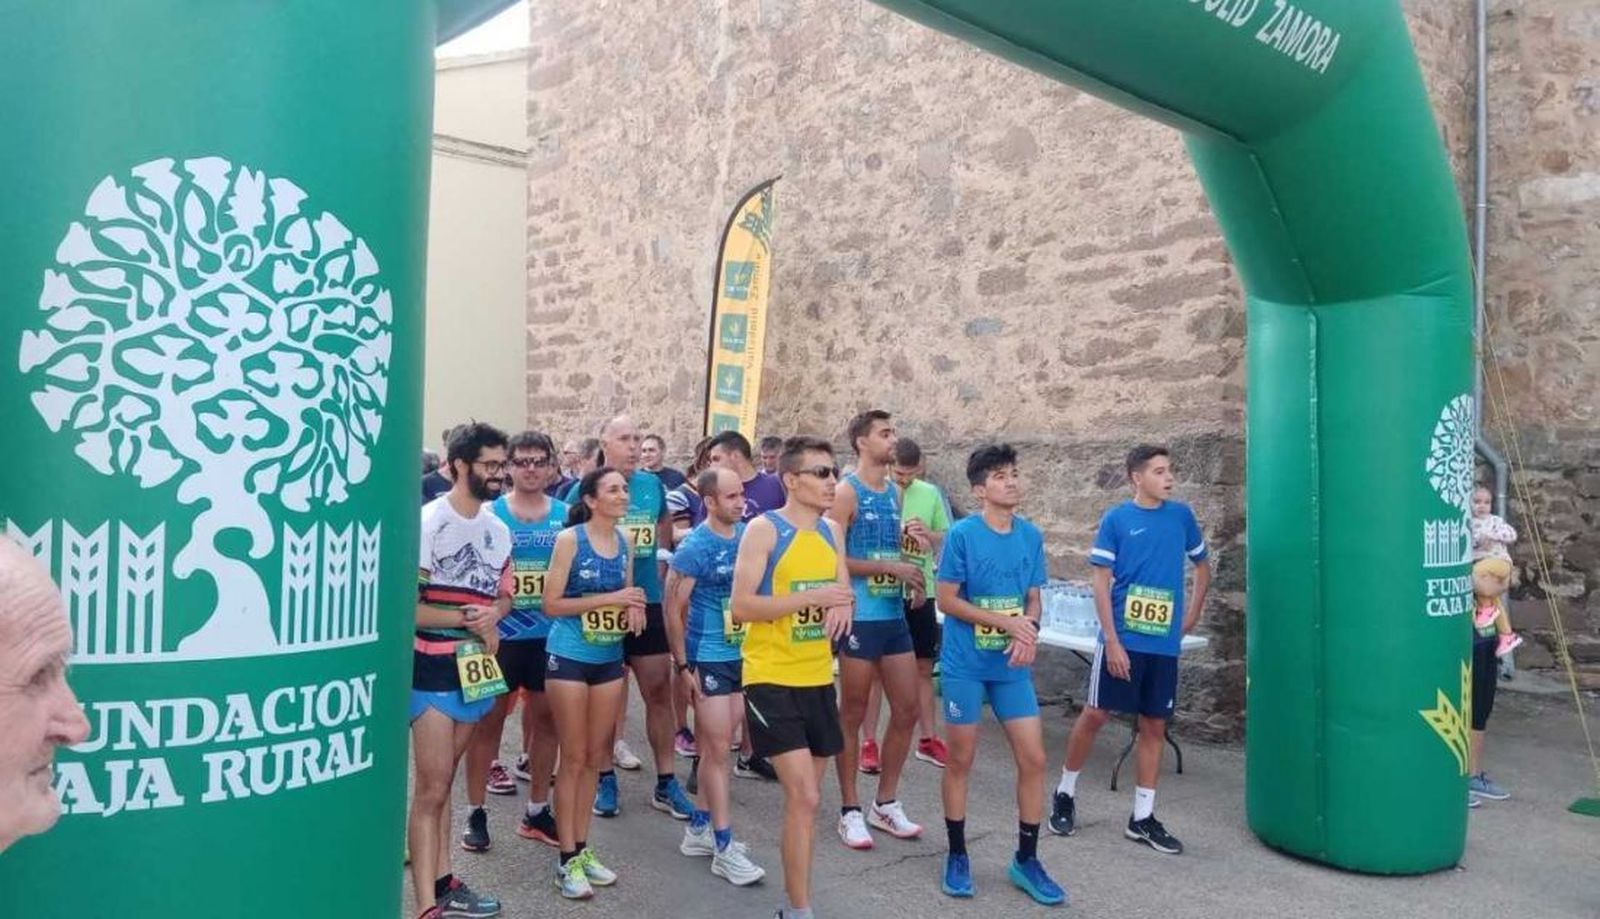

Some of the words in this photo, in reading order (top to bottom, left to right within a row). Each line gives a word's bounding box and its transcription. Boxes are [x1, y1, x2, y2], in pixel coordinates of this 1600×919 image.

[1255, 0, 1341, 74] ZAMORA
[1426, 575, 1472, 596] FUND
[798, 605, 832, 624] 93
[1130, 600, 1168, 623] 963
[1427, 596, 1463, 616] CAJA
[587, 611, 629, 631] 956
[69, 673, 377, 753] UNDACION
[53, 757, 185, 817] AJA
[201, 726, 374, 804] RURAL
